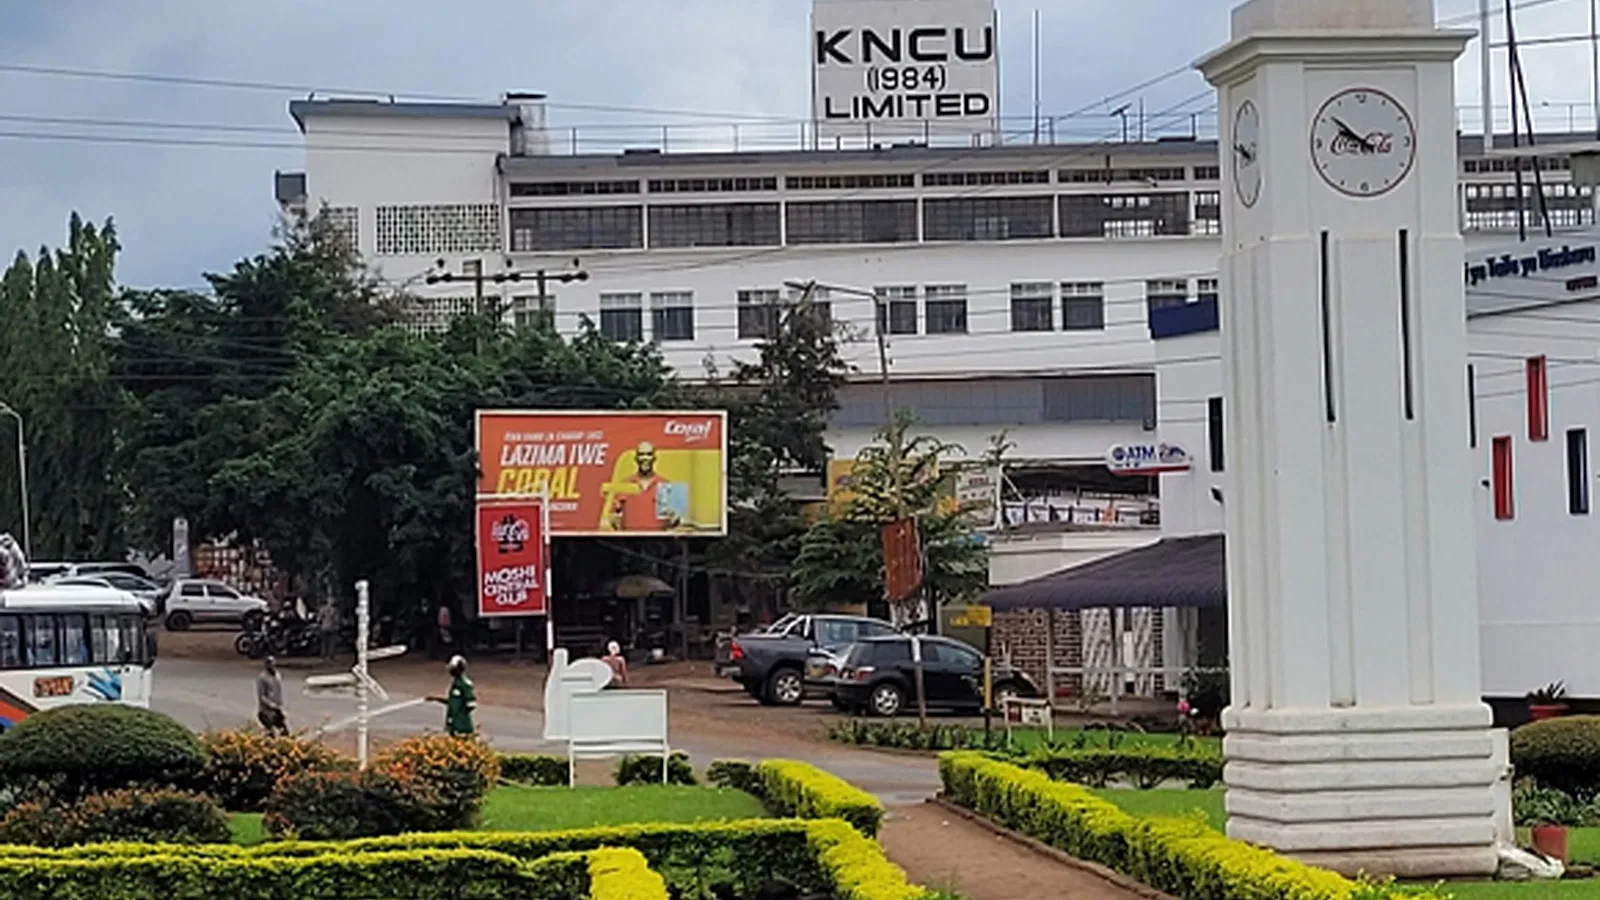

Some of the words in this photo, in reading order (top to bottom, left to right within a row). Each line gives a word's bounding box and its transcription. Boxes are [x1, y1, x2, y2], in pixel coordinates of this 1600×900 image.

[816, 26, 992, 64] KNCU
[867, 64, 946, 93] (1984)
[825, 94, 990, 118] LIMITED
[664, 420, 712, 437] Coral
[500, 443, 566, 466] LAZIMA
[569, 443, 609, 465] IWE
[1126, 446, 1157, 460] ATM
[497, 467, 580, 499] CORAL
[485, 565, 536, 585] MOSHI
[484, 579, 540, 597] CENTRAL
[495, 590, 528, 606] CLUB
